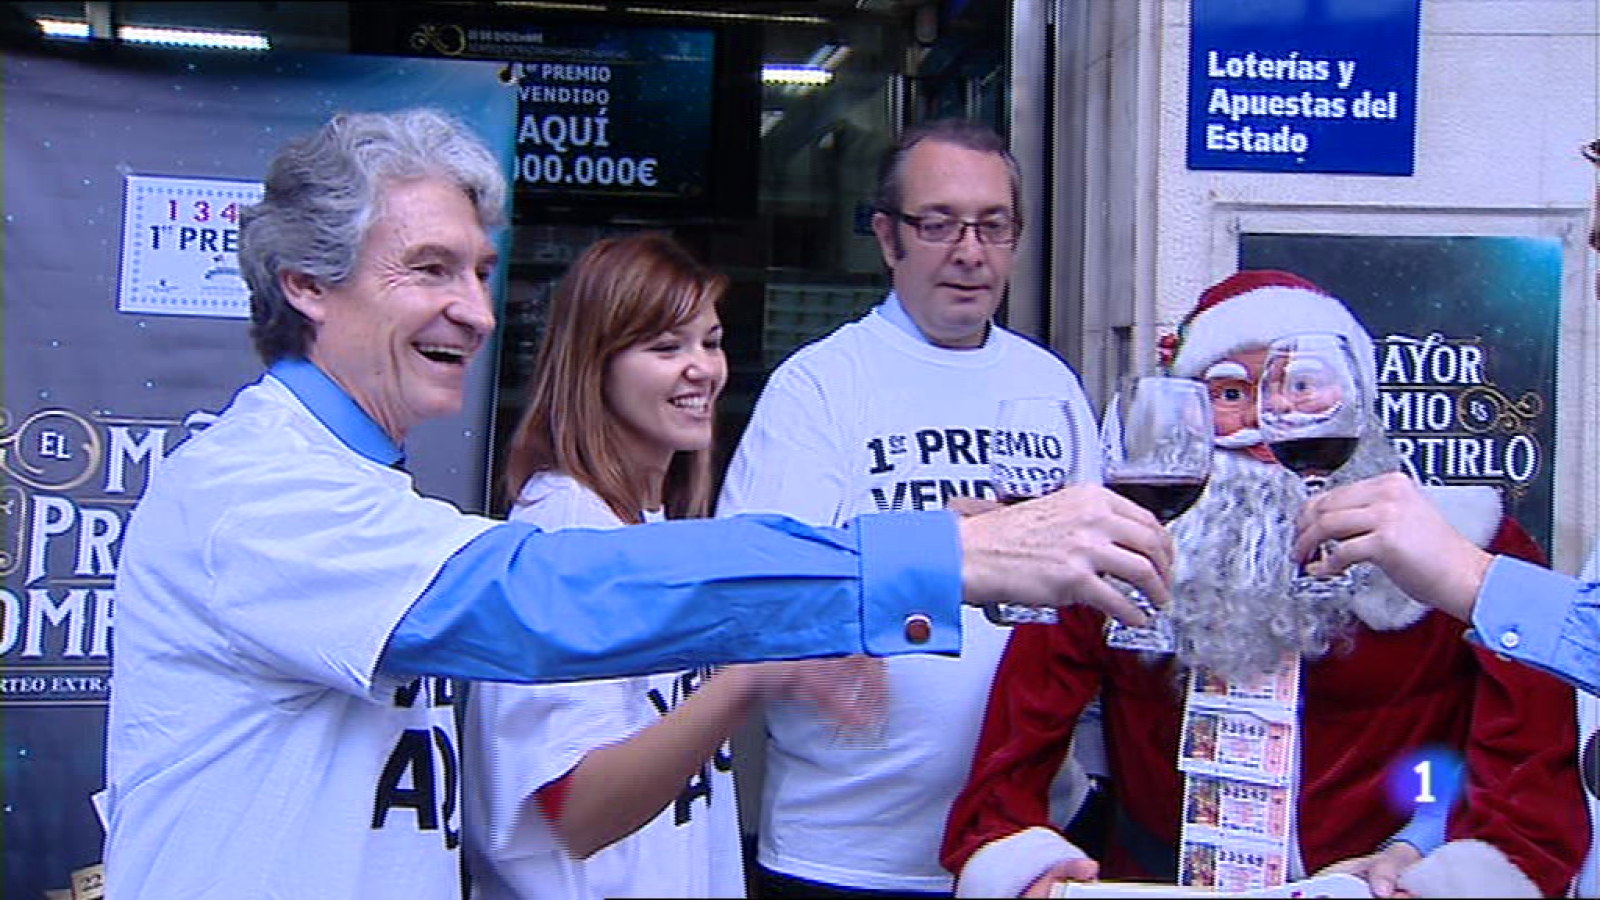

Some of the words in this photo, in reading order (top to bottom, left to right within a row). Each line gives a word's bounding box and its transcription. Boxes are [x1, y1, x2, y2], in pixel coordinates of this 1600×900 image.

[541, 64, 612, 83] PREMIO
[1207, 50, 1331, 81] Loterías
[1337, 60, 1356, 89] y
[518, 85, 610, 105] VENDIDO
[1207, 88, 1348, 121] Apuestas
[1352, 90, 1398, 120] del
[518, 107, 610, 152] AQUÍ
[1205, 123, 1309, 154] Estado
[41, 432, 71, 459] EL
